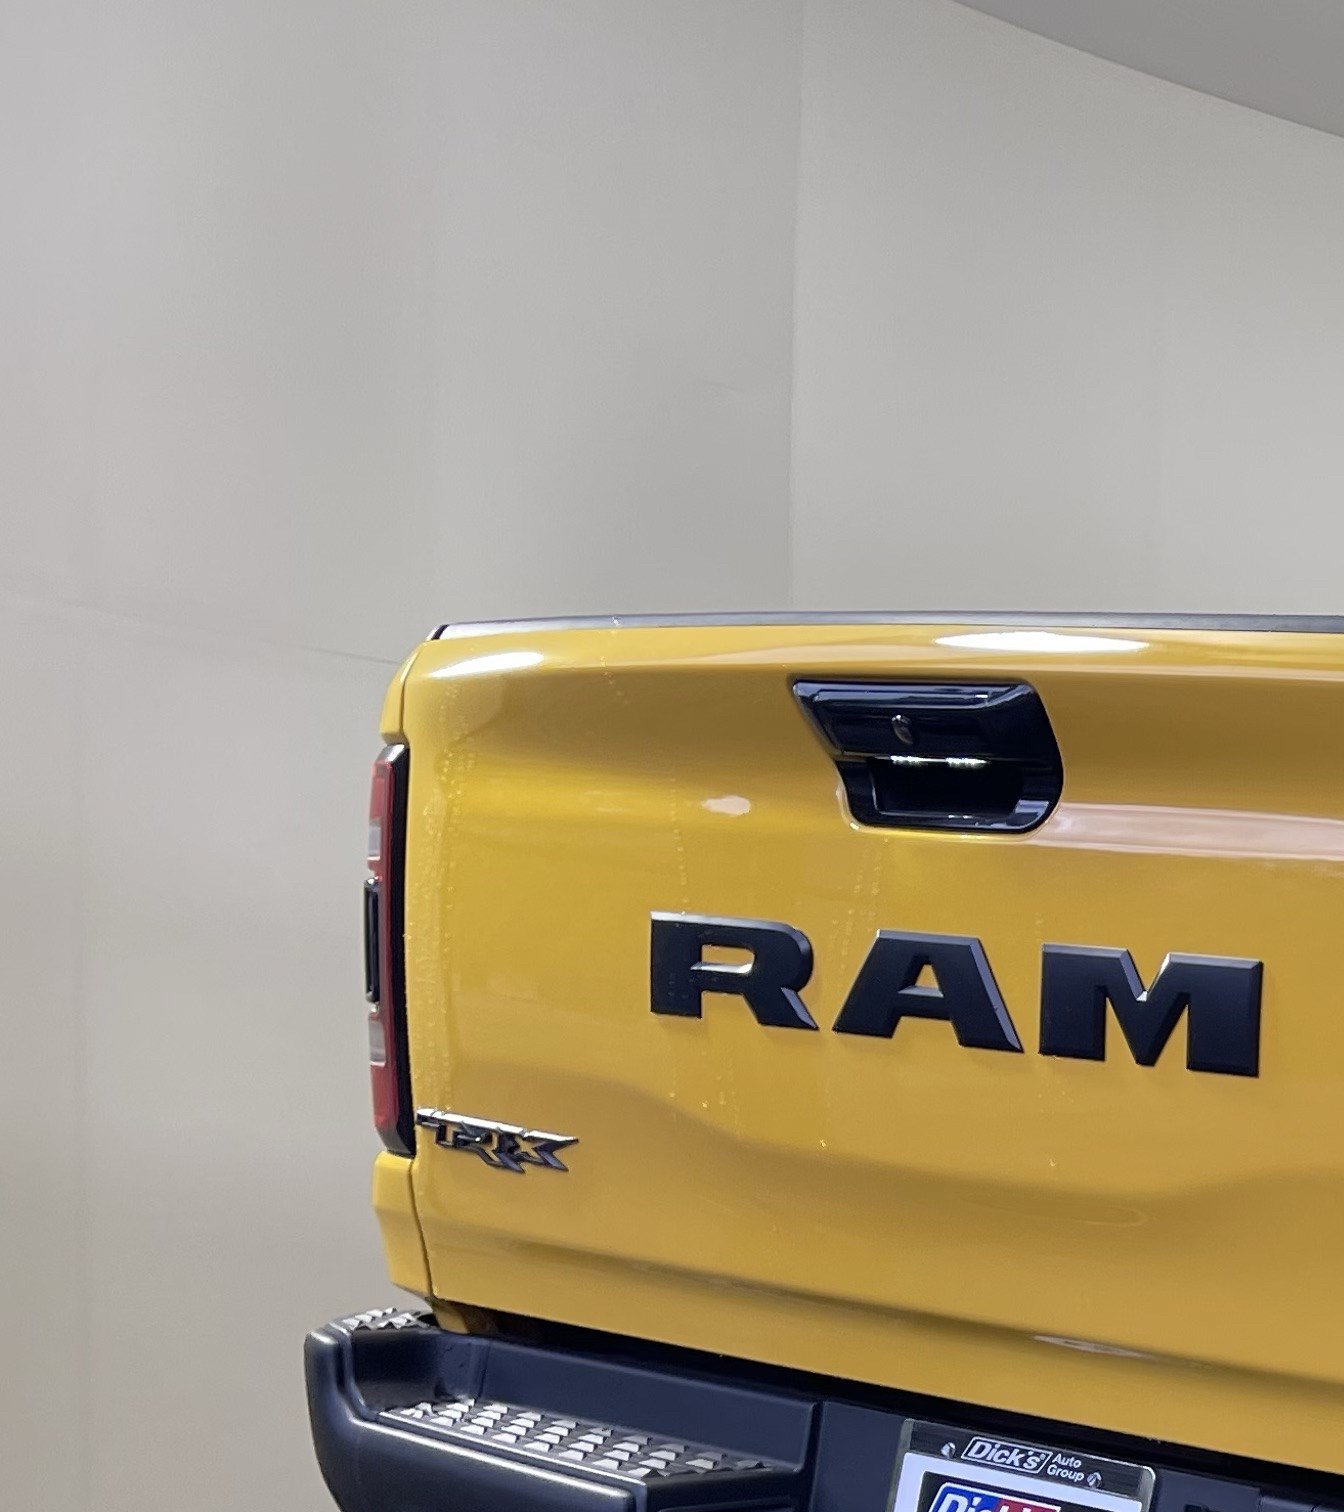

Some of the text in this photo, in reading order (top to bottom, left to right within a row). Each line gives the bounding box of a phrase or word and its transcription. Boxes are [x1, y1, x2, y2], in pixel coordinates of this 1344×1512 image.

[650, 911, 1264, 1078] RAM
[415, 1107, 579, 1175] TRX
[1047, 1464, 1085, 1482] Group
[1051, 1453, 1082, 1469] Auto
